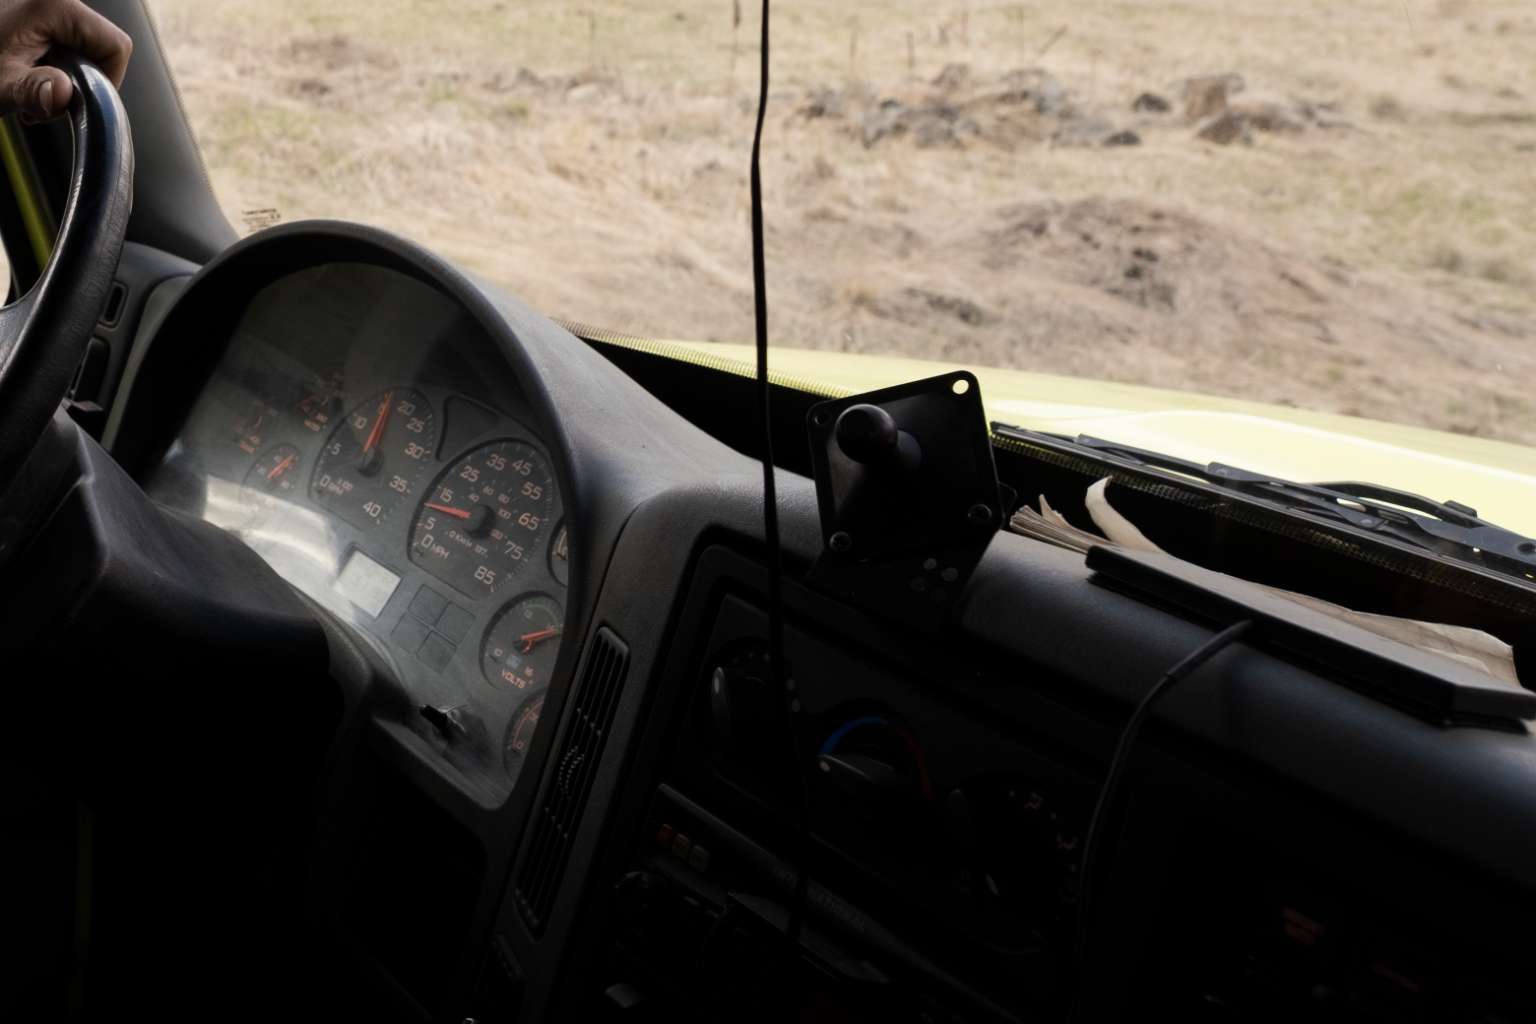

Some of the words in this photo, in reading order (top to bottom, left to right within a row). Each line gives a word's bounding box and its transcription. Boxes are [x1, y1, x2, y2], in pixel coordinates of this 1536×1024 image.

[396, 400, 416, 416] 20
[406, 417, 425, 433] 25
[331, 442, 343, 455] 5
[404, 442, 425, 459] 30
[486, 453, 508, 472] 35
[511, 459, 532, 476] 45
[320, 475, 332, 488] 0
[460, 465, 480, 482] 25
[389, 475, 409, 493] 35
[521, 481, 543, 500] 55
[439, 487, 454, 502] 15
[363, 502, 382, 517] 40
[425, 516, 437, 530] 5
[518, 512, 539, 530] 65
[421, 534, 434, 548] 0
[504, 540, 524, 560] 75
[474, 565, 496, 585] 85
[501, 668, 526, 689] VOLTS
